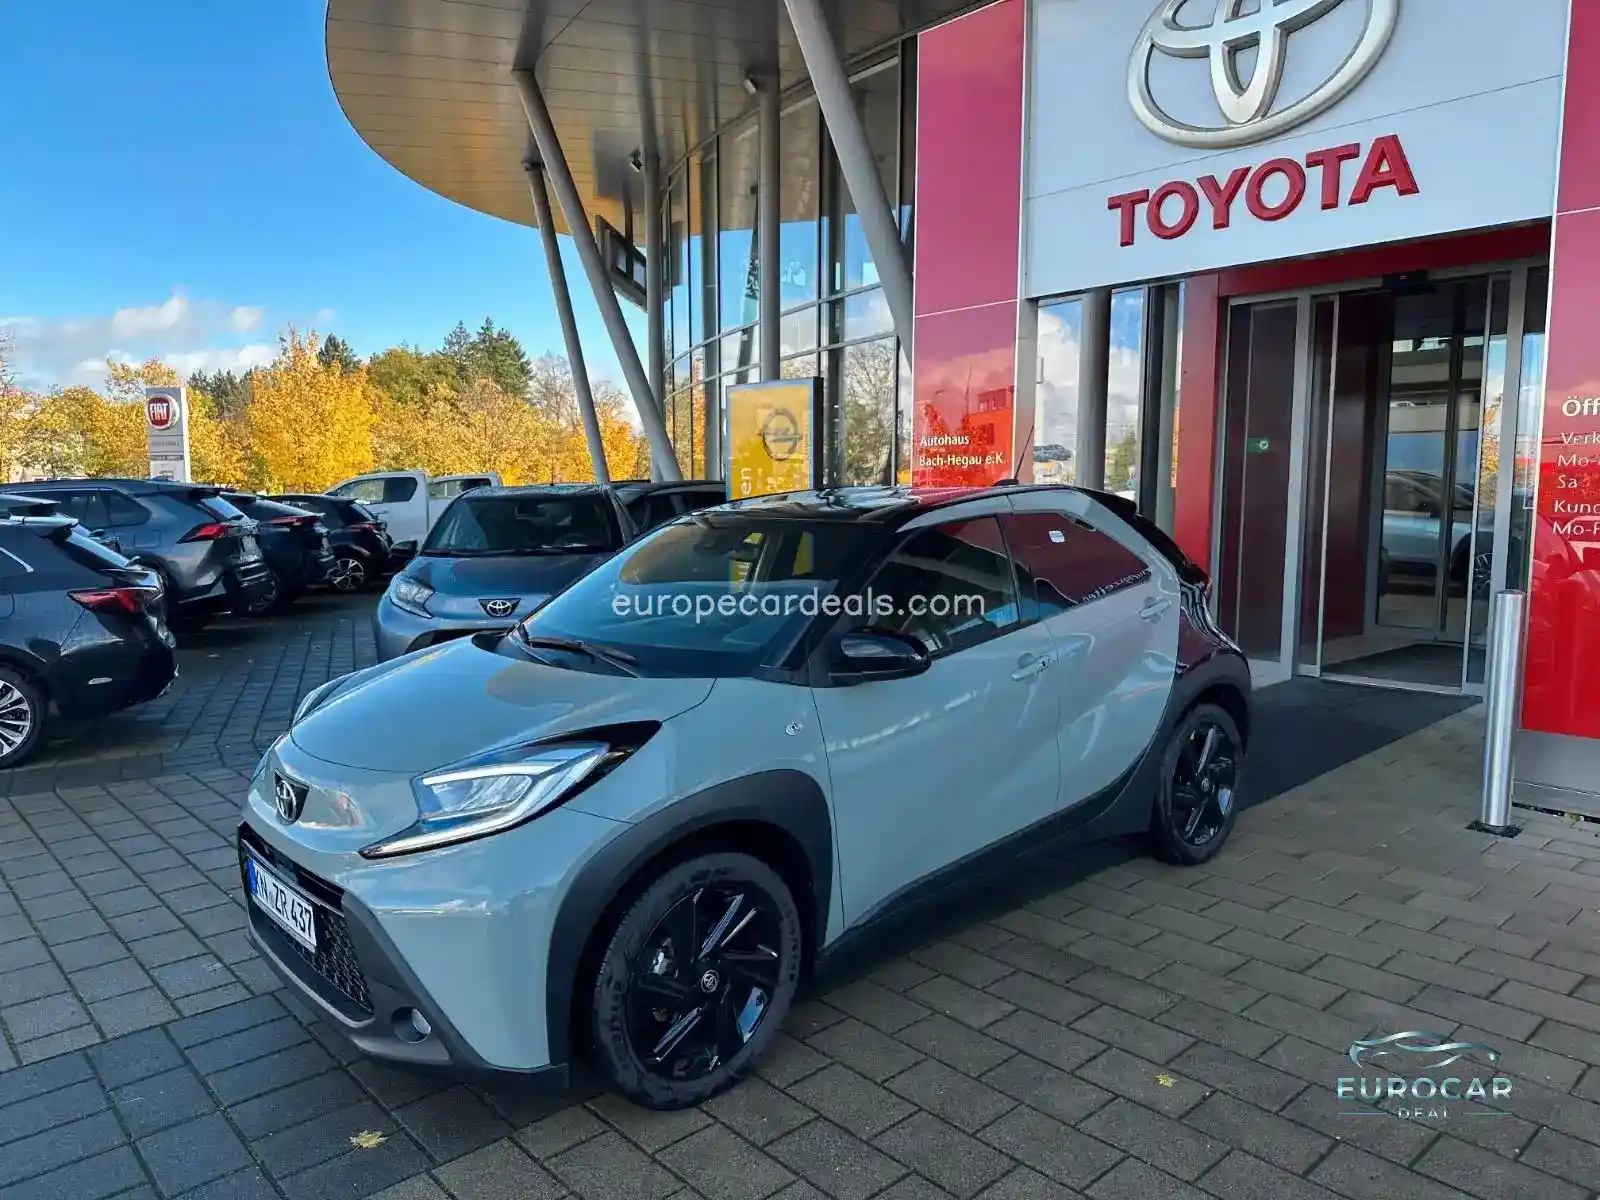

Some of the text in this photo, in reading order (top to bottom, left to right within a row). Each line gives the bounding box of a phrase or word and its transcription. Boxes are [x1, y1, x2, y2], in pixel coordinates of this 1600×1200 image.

[1107, 133, 1420, 248] TOYOTA
[149, 403, 168, 420] FIAT
[920, 434, 970, 447] Autohaus
[919, 453, 982, 469] Bach-Hegau
[1557, 453, 1600, 468] Mo-
[1556, 474, 1578, 489] Sa
[272, 882, 290, 921] ZR
[291, 898, 312, 938] 437
